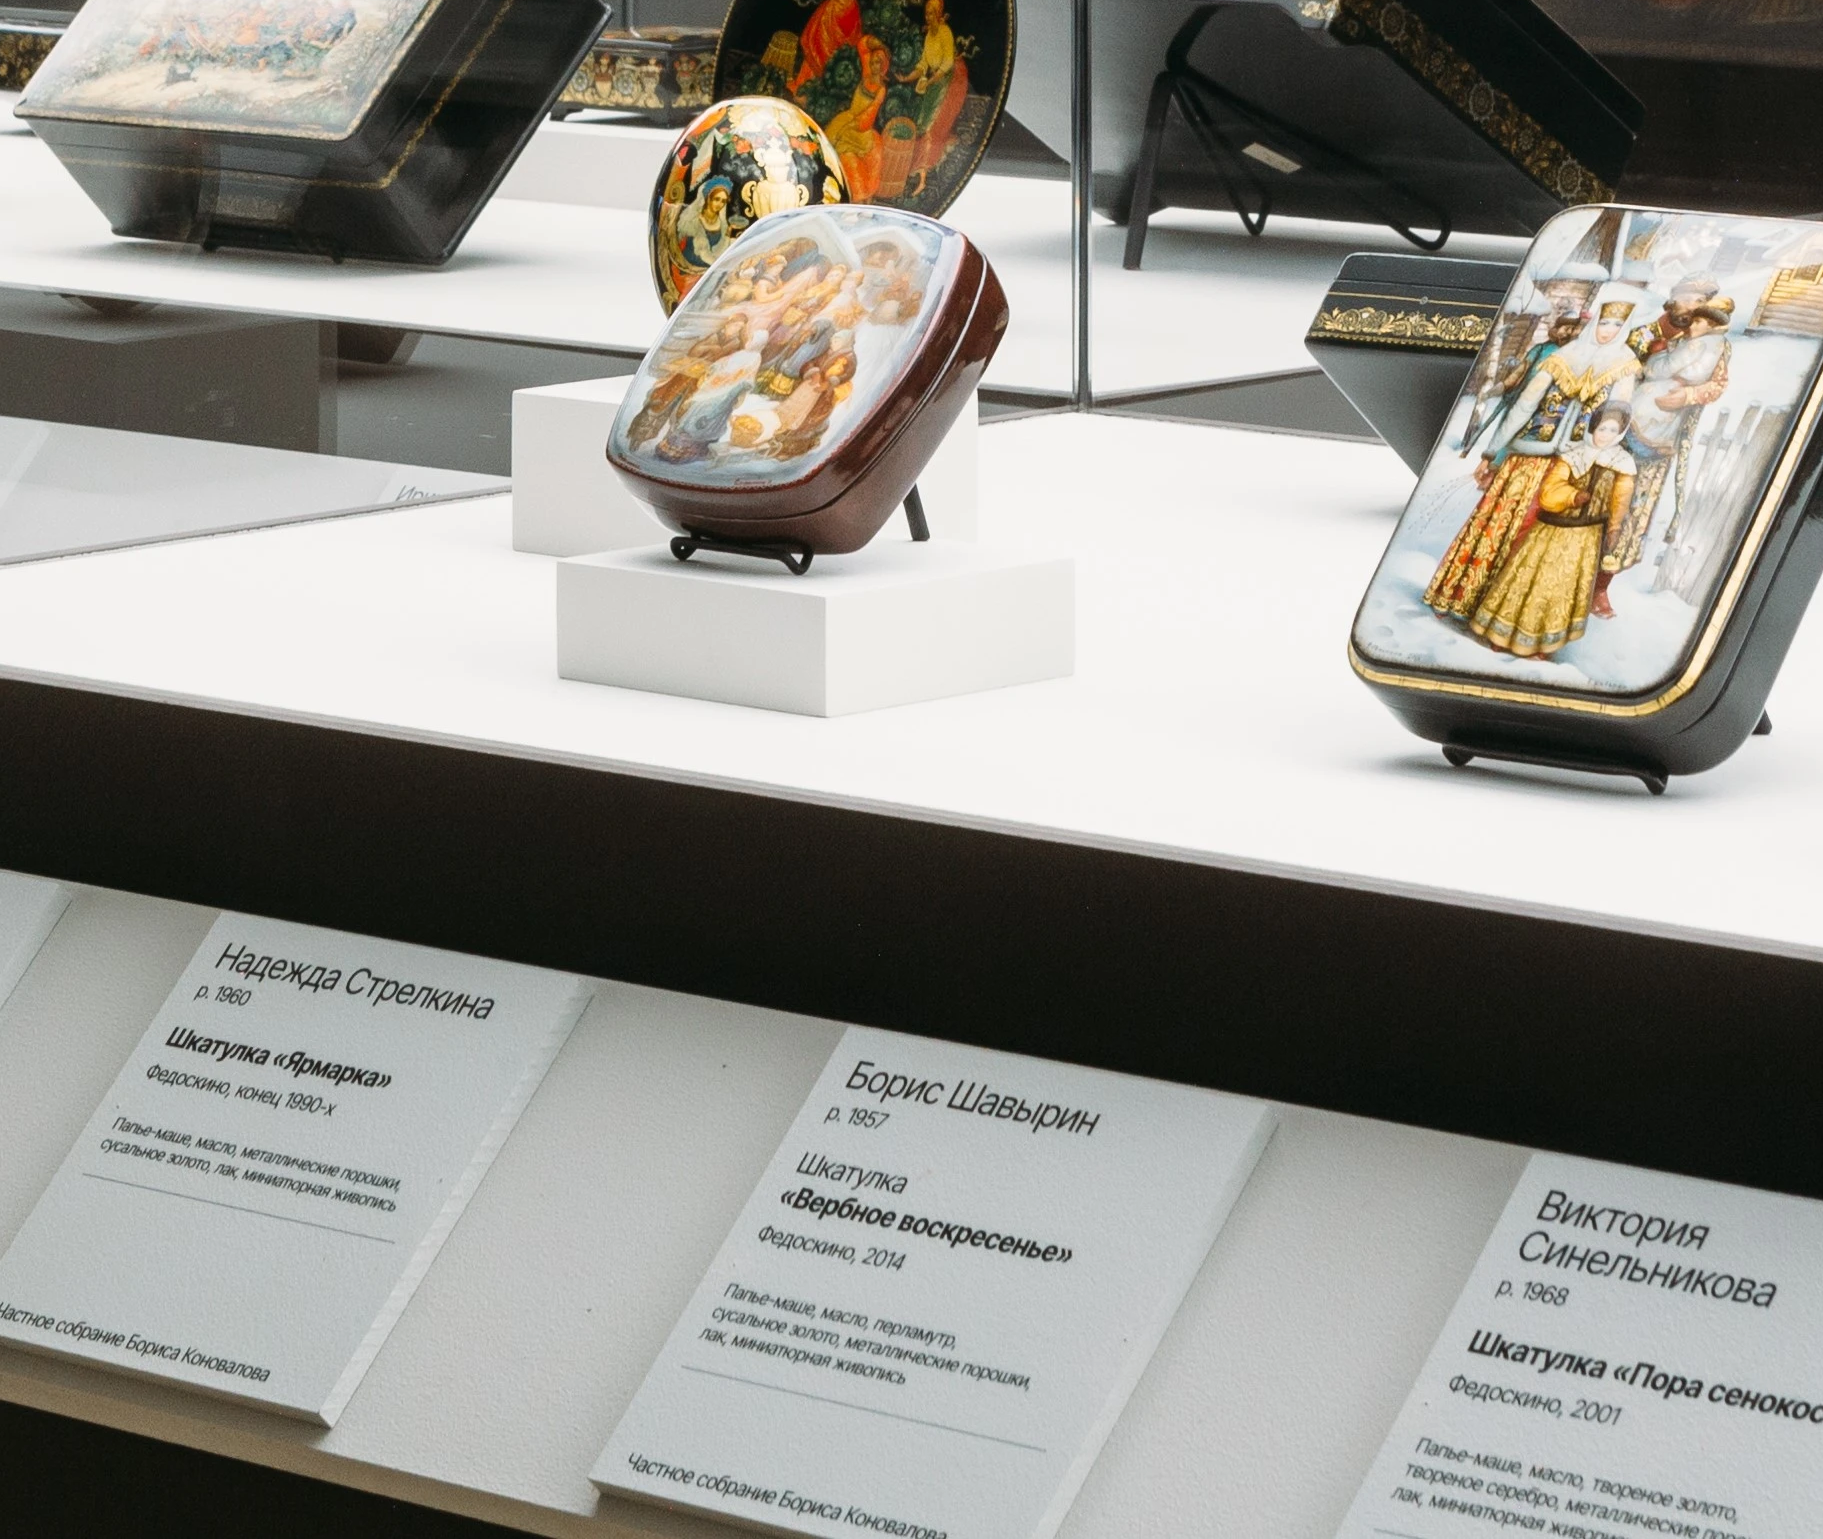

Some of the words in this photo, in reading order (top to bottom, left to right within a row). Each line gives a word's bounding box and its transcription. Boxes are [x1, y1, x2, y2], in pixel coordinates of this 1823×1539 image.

[192, 985, 210, 1001] р.
[214, 985, 253, 1007] 1960
[214, 942, 343, 994] Надежда
[345, 967, 495, 1020] Стрелкина
[146, 1063, 231, 1099] Федоскино,
[234, 1085, 283, 1110] конец
[284, 1091, 337, 1117] 1990-х
[164, 1026, 271, 1066] Шкатулка
[273, 1050, 392, 1088] «Ярмарка»
[823, 1106, 841, 1124] р.
[847, 1107, 891, 1130] 1957
[845, 1060, 945, 1105] Борис
[946, 1079, 1101, 1136] Шавырин
[100, 1138, 167, 1162] сусальное
[166, 1152, 211, 1175] золото,
[213, 1163, 240, 1181] лак,
[241, 1169, 333, 1198] миниатюрная
[331, 1188, 397, 1213] живопись
[111, 1116, 193, 1149] Папье-маше,
[194, 1137, 238, 1158] масло,
[239, 1146, 341, 1178] металлические
[339, 1168, 401, 1194] порошки,
[795, 1151, 909, 1195] Шкатулка
[757, 1224, 856, 1265] Федоскино,
[861, 1247, 907, 1271] 2014
[780, 1186, 897, 1229] «Вербное
[897, 1214, 1073, 1263] воскресенье»
[1536, 1189, 1711, 1251] Виктория
[1494, 1279, 1514, 1299] р.
[1522, 1280, 1571, 1307] 1968
[1518, 1230, 1778, 1309] Синельникова
[711, 1306, 788, 1334] сусальное
[788, 1324, 840, 1349] золото,
[844, 1336, 961, 1373] металлические
[960, 1362, 1031, 1392] порошки,
[723, 1282, 817, 1320] Папье-маше,
[820, 1307, 869, 1331] масло,
[873, 1318, 956, 1351] перламутр,
[55, 1320, 126, 1348] собрание
[124, 1333, 182, 1361] Бориса
[180, 1346, 271, 1383] Коновалова
[698, 1327, 728, 1347] лак,
[730, 1334, 833, 1368] миниатюрная
[832, 1358, 907, 1385] живопись
[1467, 1329, 1608, 1380] Шкатулка
[1613, 1361, 1704, 1400] «Пора
[1448, 1374, 1563, 1419] Федоскино,
[1569, 1398, 1623, 1426] 2001
[627, 1452, 696, 1485] Частное
[695, 1473, 778, 1505] собрание
[777, 1489, 843, 1521] Бориса
[1390, 1486, 1423, 1508] лак,
[1428, 1494, 1547, 1532] миниатюрная
[1405, 1462, 1484, 1492] твореное
[1485, 1482, 1559, 1512] серебро,
[1565, 1499, 1700, 1539] металлические
[1415, 1436, 1523, 1478] Папье-маше,
[1528, 1464, 1584, 1491] масло,
[1593, 1477, 1674, 1507] твореное
[1675, 1496, 1738, 1525] золото,
